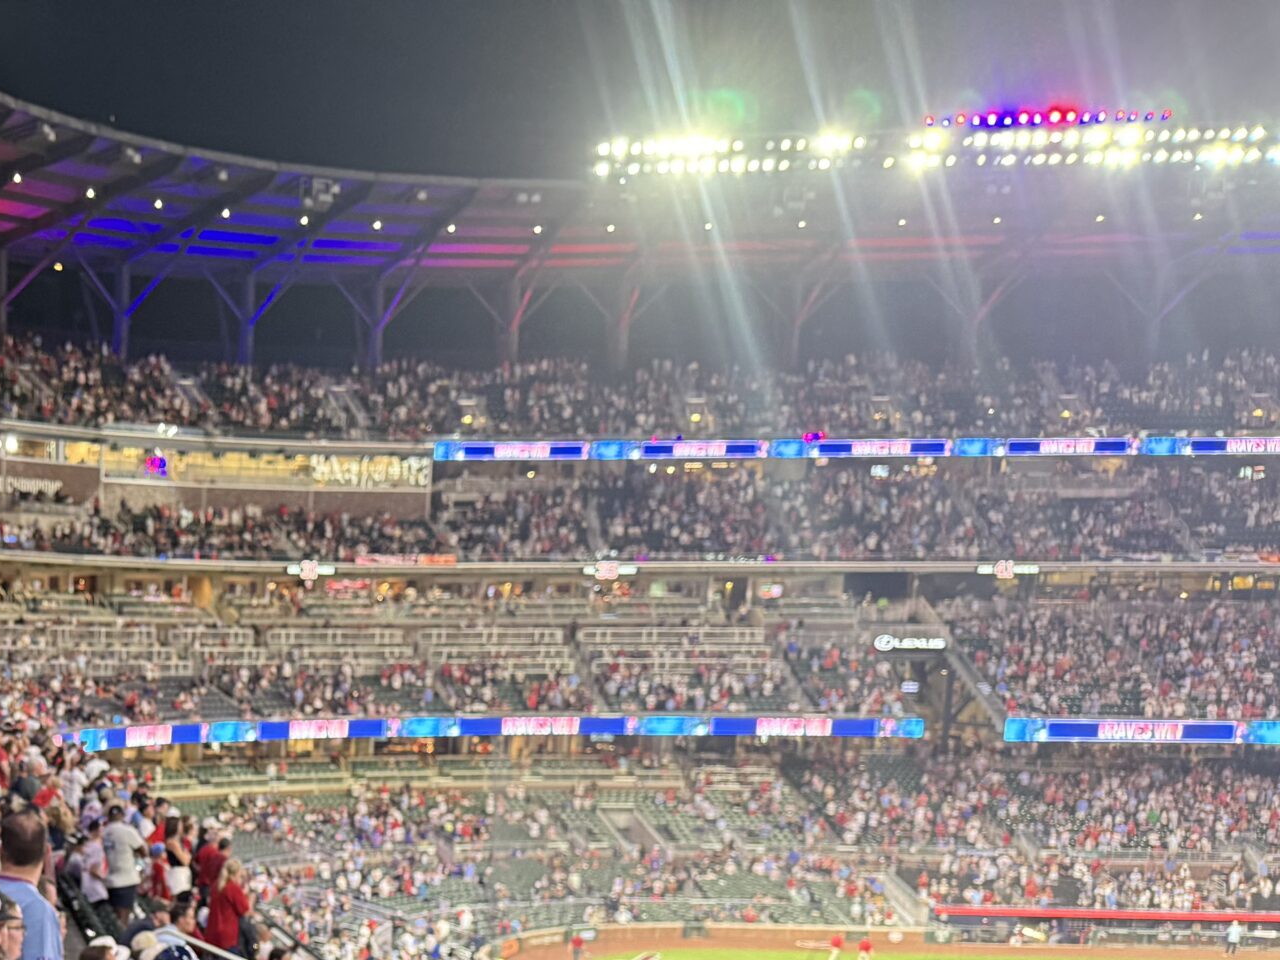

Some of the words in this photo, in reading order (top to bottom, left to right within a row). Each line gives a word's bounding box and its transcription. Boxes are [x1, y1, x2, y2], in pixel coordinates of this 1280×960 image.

[894, 637, 946, 649] LEXUS
[1098, 722, 1152, 740] BRAVES
[1153, 722, 1183, 740] WIN
